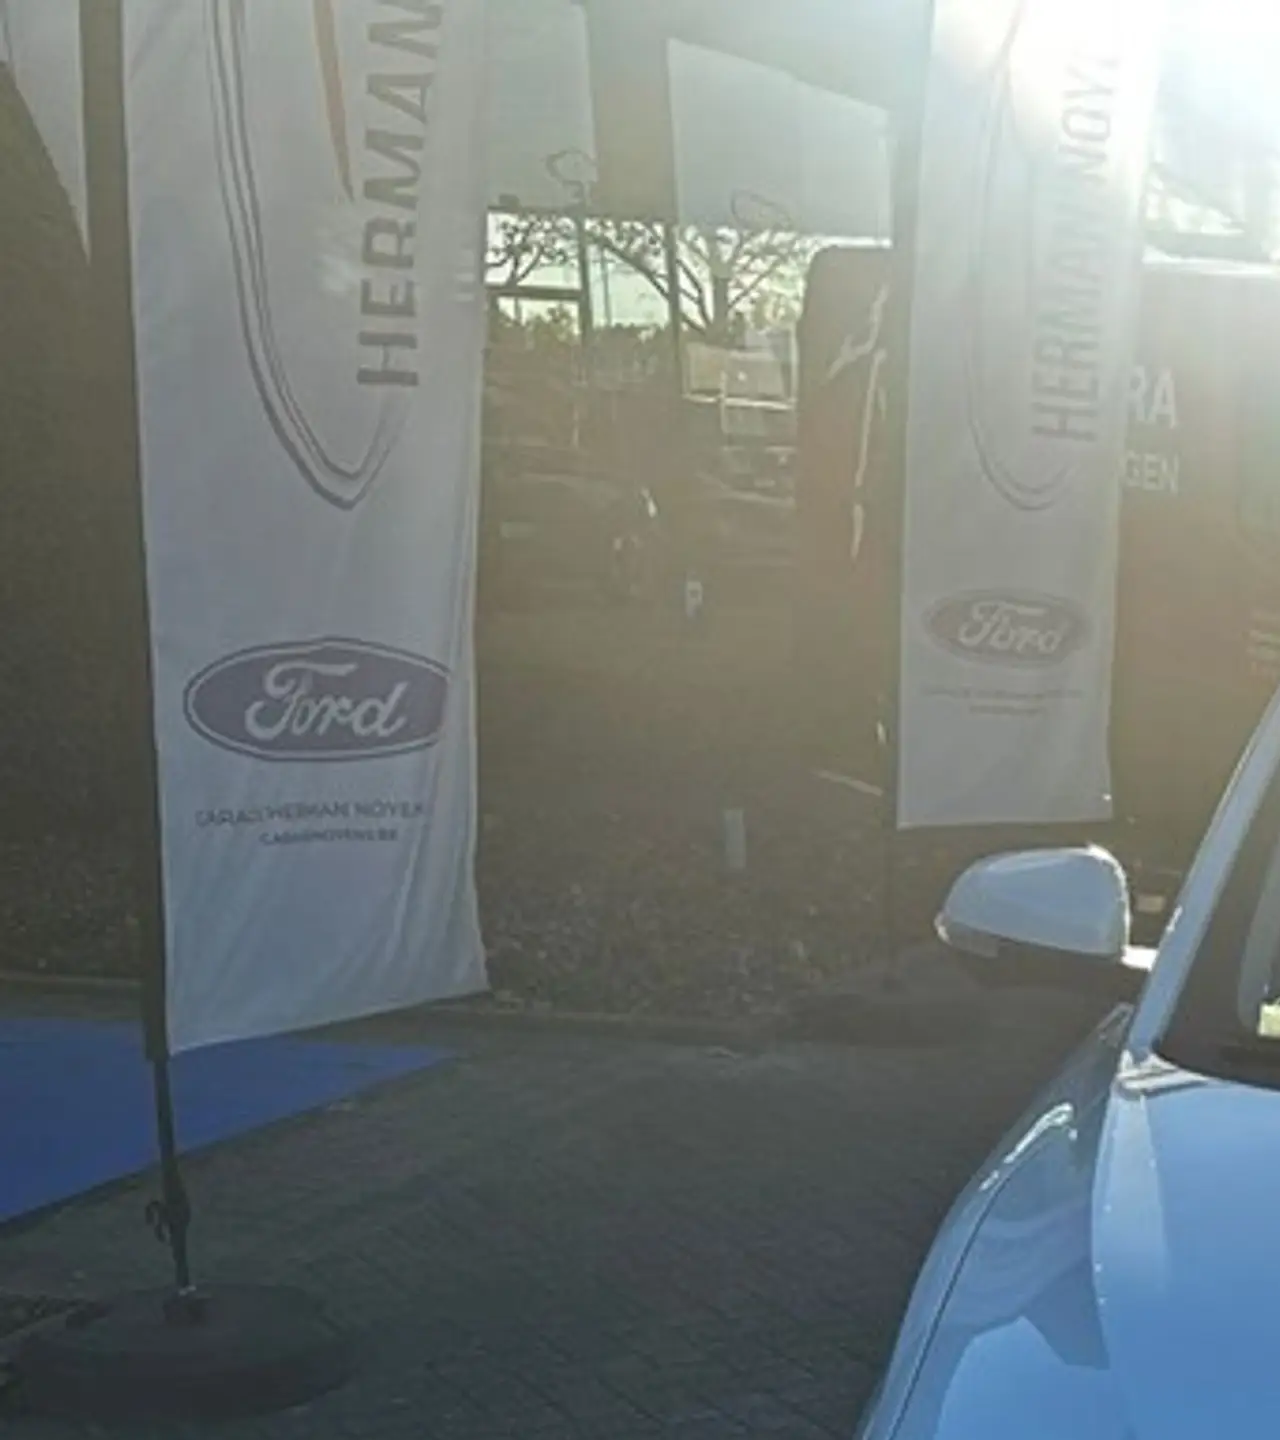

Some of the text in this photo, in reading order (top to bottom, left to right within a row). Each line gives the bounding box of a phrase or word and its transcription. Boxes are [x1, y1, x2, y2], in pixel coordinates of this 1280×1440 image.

[356, 0, 443, 387] HERMAN
[960, 600, 1072, 656] Ford
[244, 660, 409, 739] Ford
